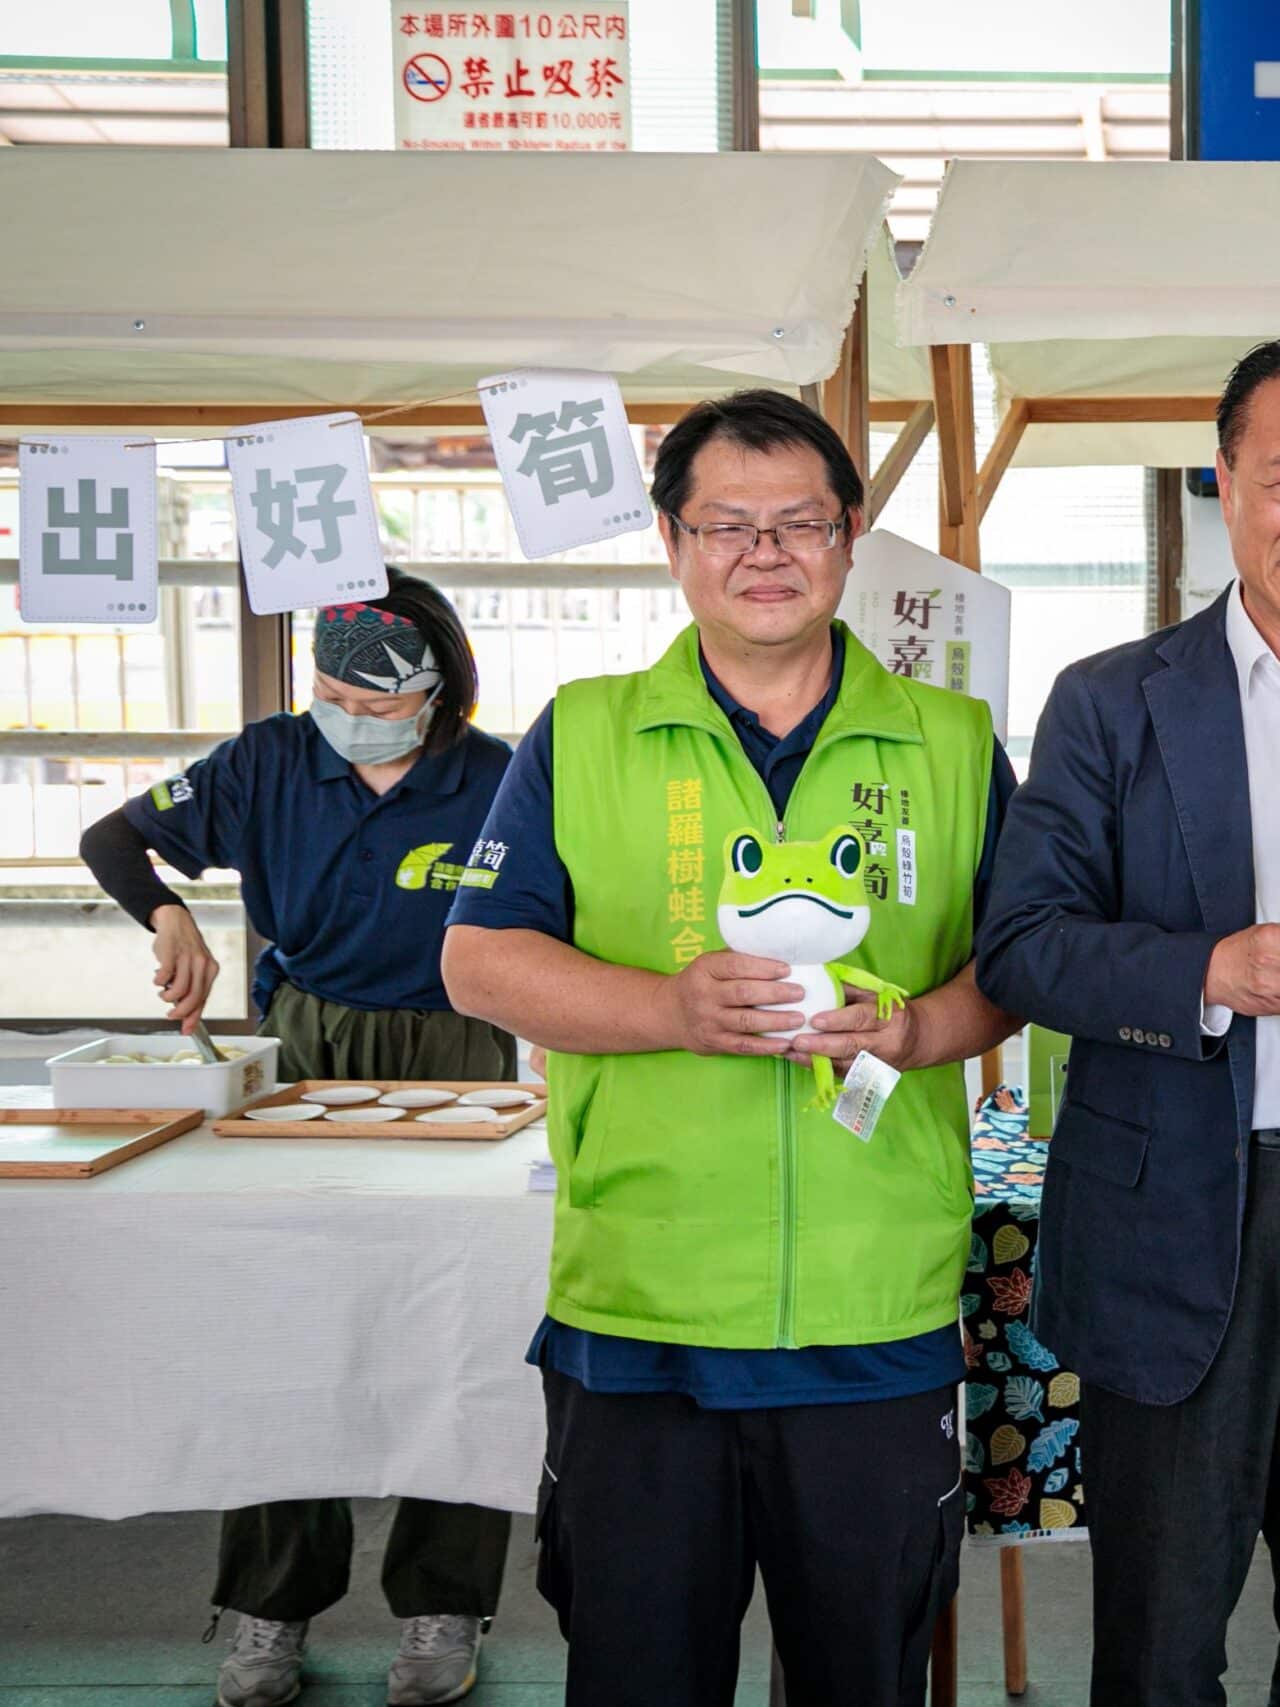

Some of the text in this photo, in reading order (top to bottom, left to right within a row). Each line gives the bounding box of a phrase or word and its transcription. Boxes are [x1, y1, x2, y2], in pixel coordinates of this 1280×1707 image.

[399, 13, 627, 41] 本場所外圍10公尺內
[459, 56, 624, 99] 禁止吸菸
[42, 398, 617, 581] 出 好 筍
[665, 780, 707, 967] 諸羅樹蛙合
